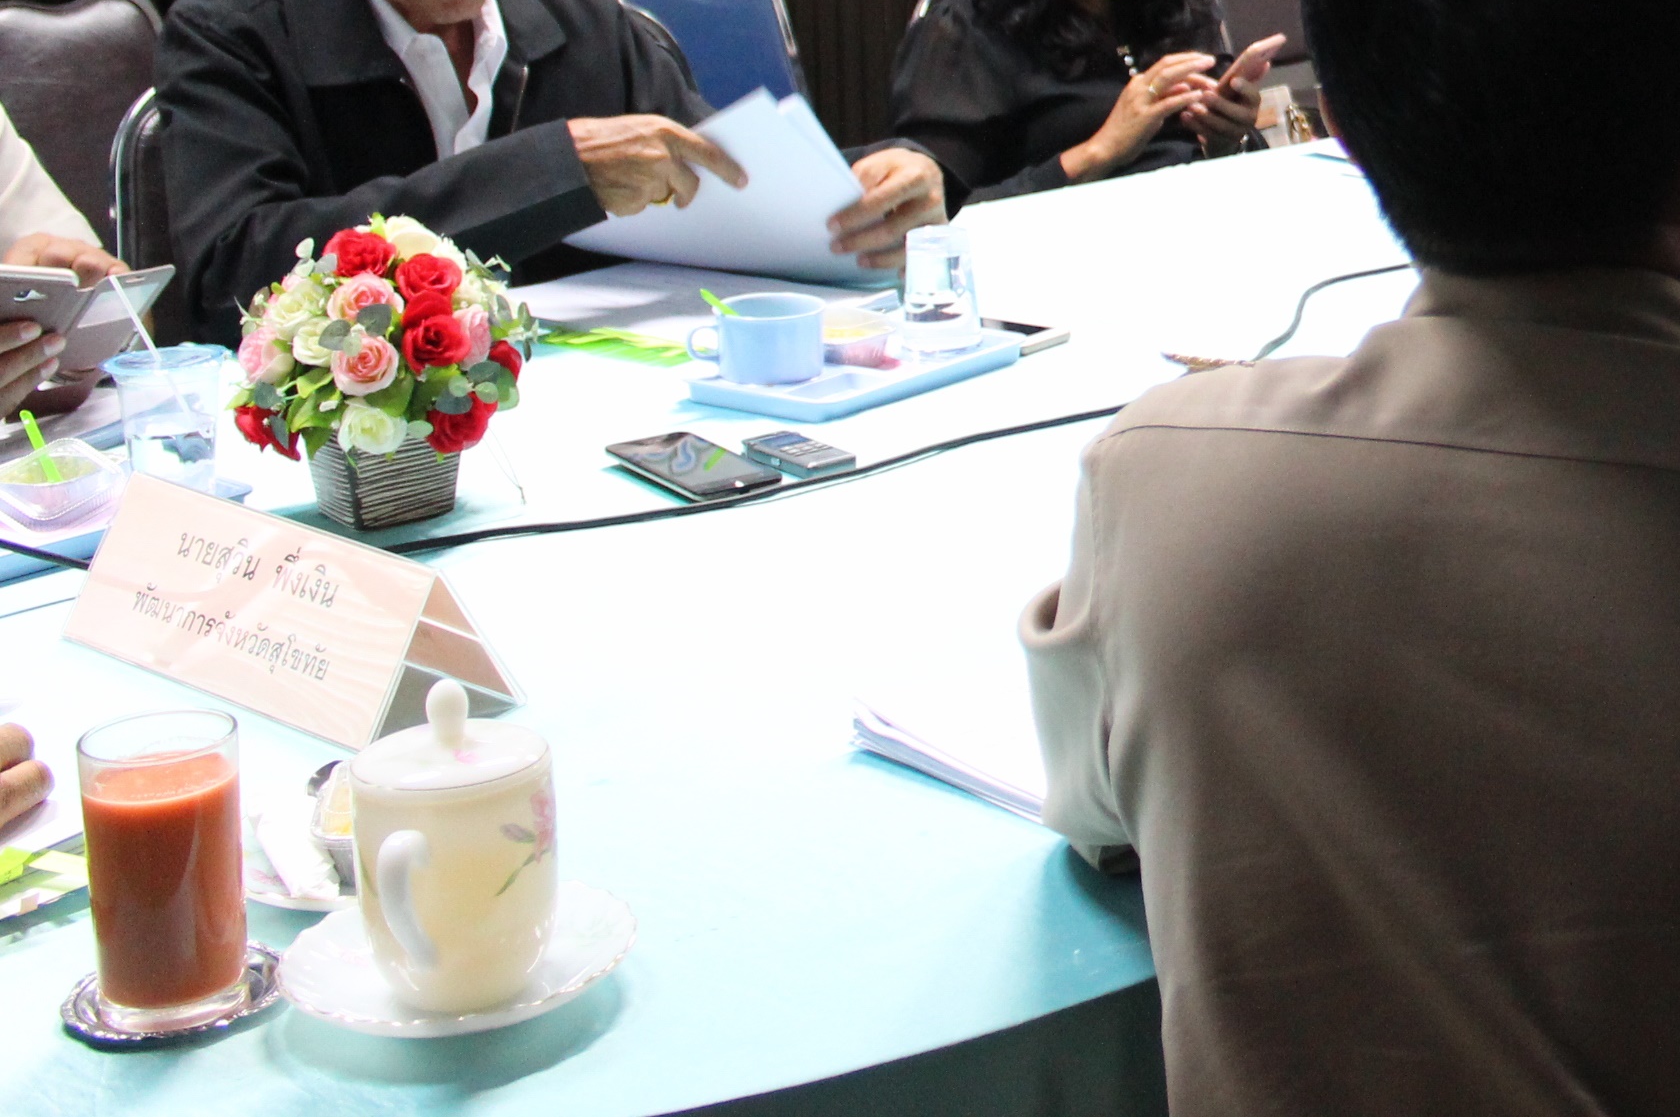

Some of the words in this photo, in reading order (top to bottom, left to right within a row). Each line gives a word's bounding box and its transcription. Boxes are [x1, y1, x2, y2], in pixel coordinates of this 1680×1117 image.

[177, 532, 260, 584] นายสุวิน
[132, 582, 331, 681] พัฒนาการจังหวัดสุโขทัย
